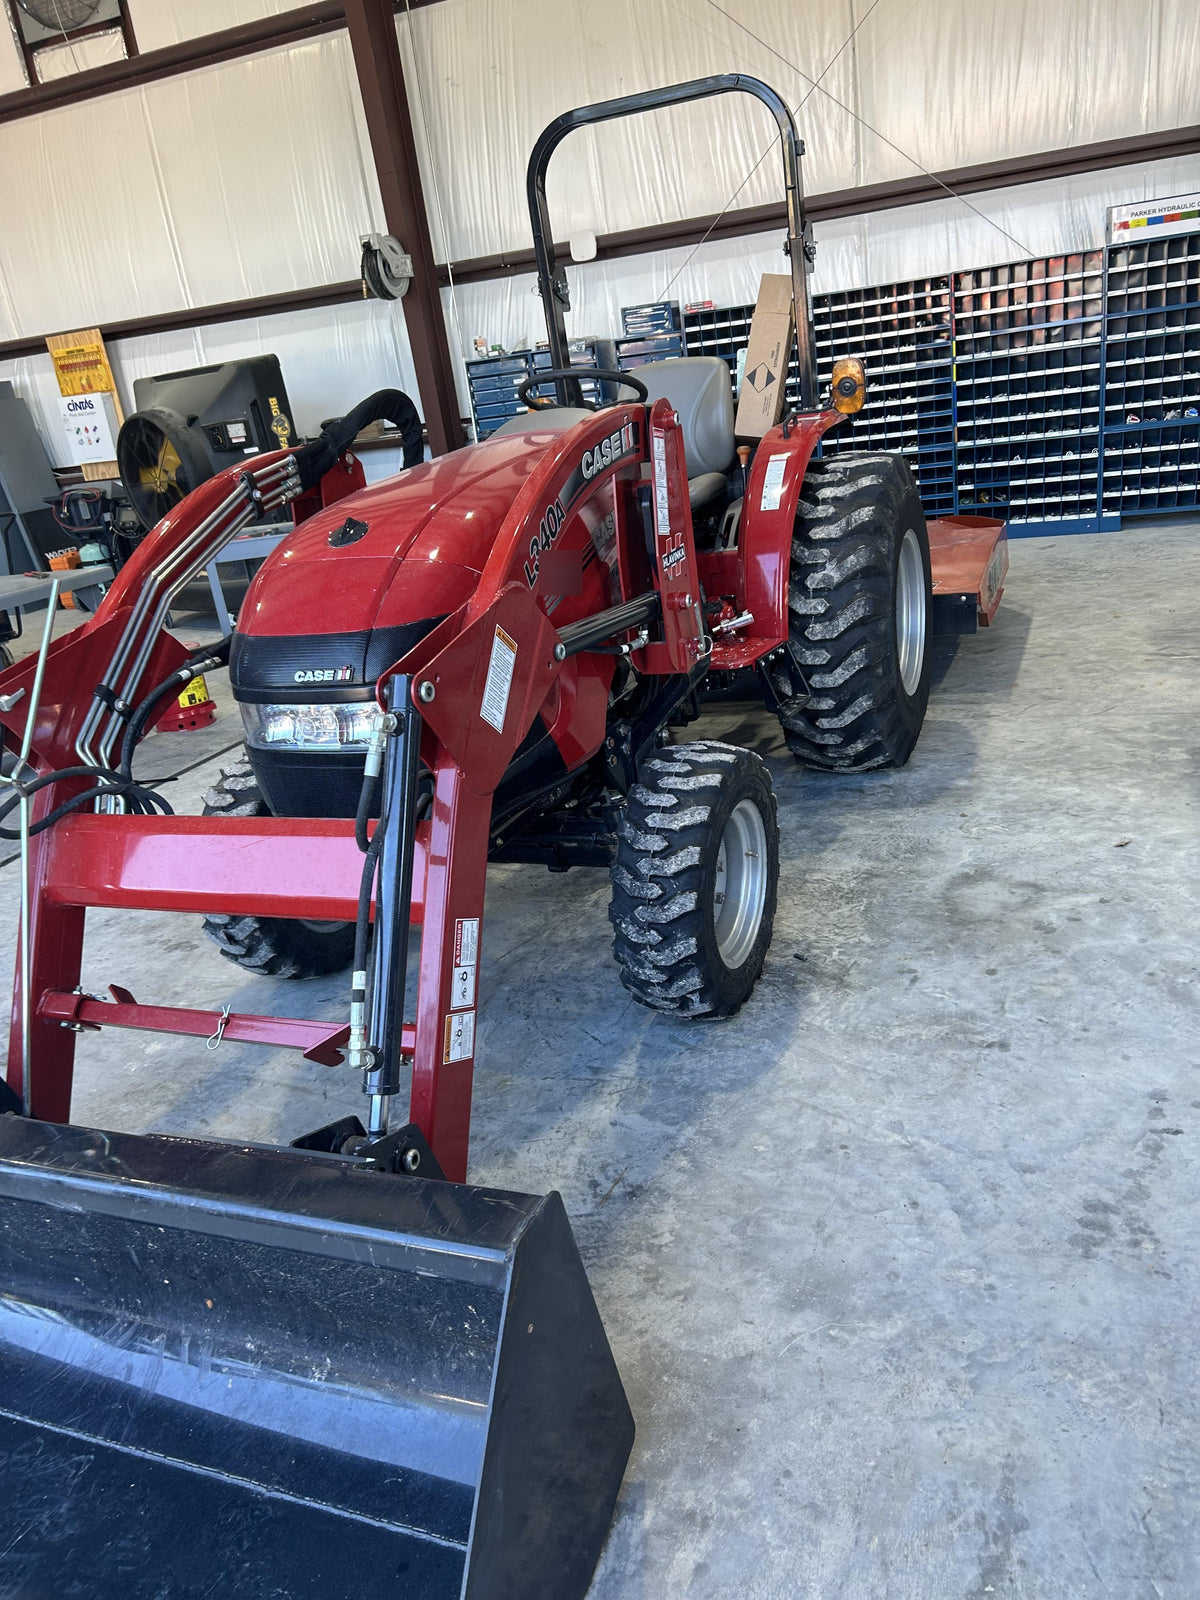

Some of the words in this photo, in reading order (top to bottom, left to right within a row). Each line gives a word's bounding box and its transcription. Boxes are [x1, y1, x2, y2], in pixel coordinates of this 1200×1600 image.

[1130, 208, 1157, 218] PARKER
[1158, 202, 1196, 213] HYDRAULIC
[268, 396, 281, 417] BIG
[591, 511, 615, 546] CAS
[523, 498, 566, 590] L340A
[663, 547, 685, 568] HLAVINKA
[294, 669, 335, 683] CASE
